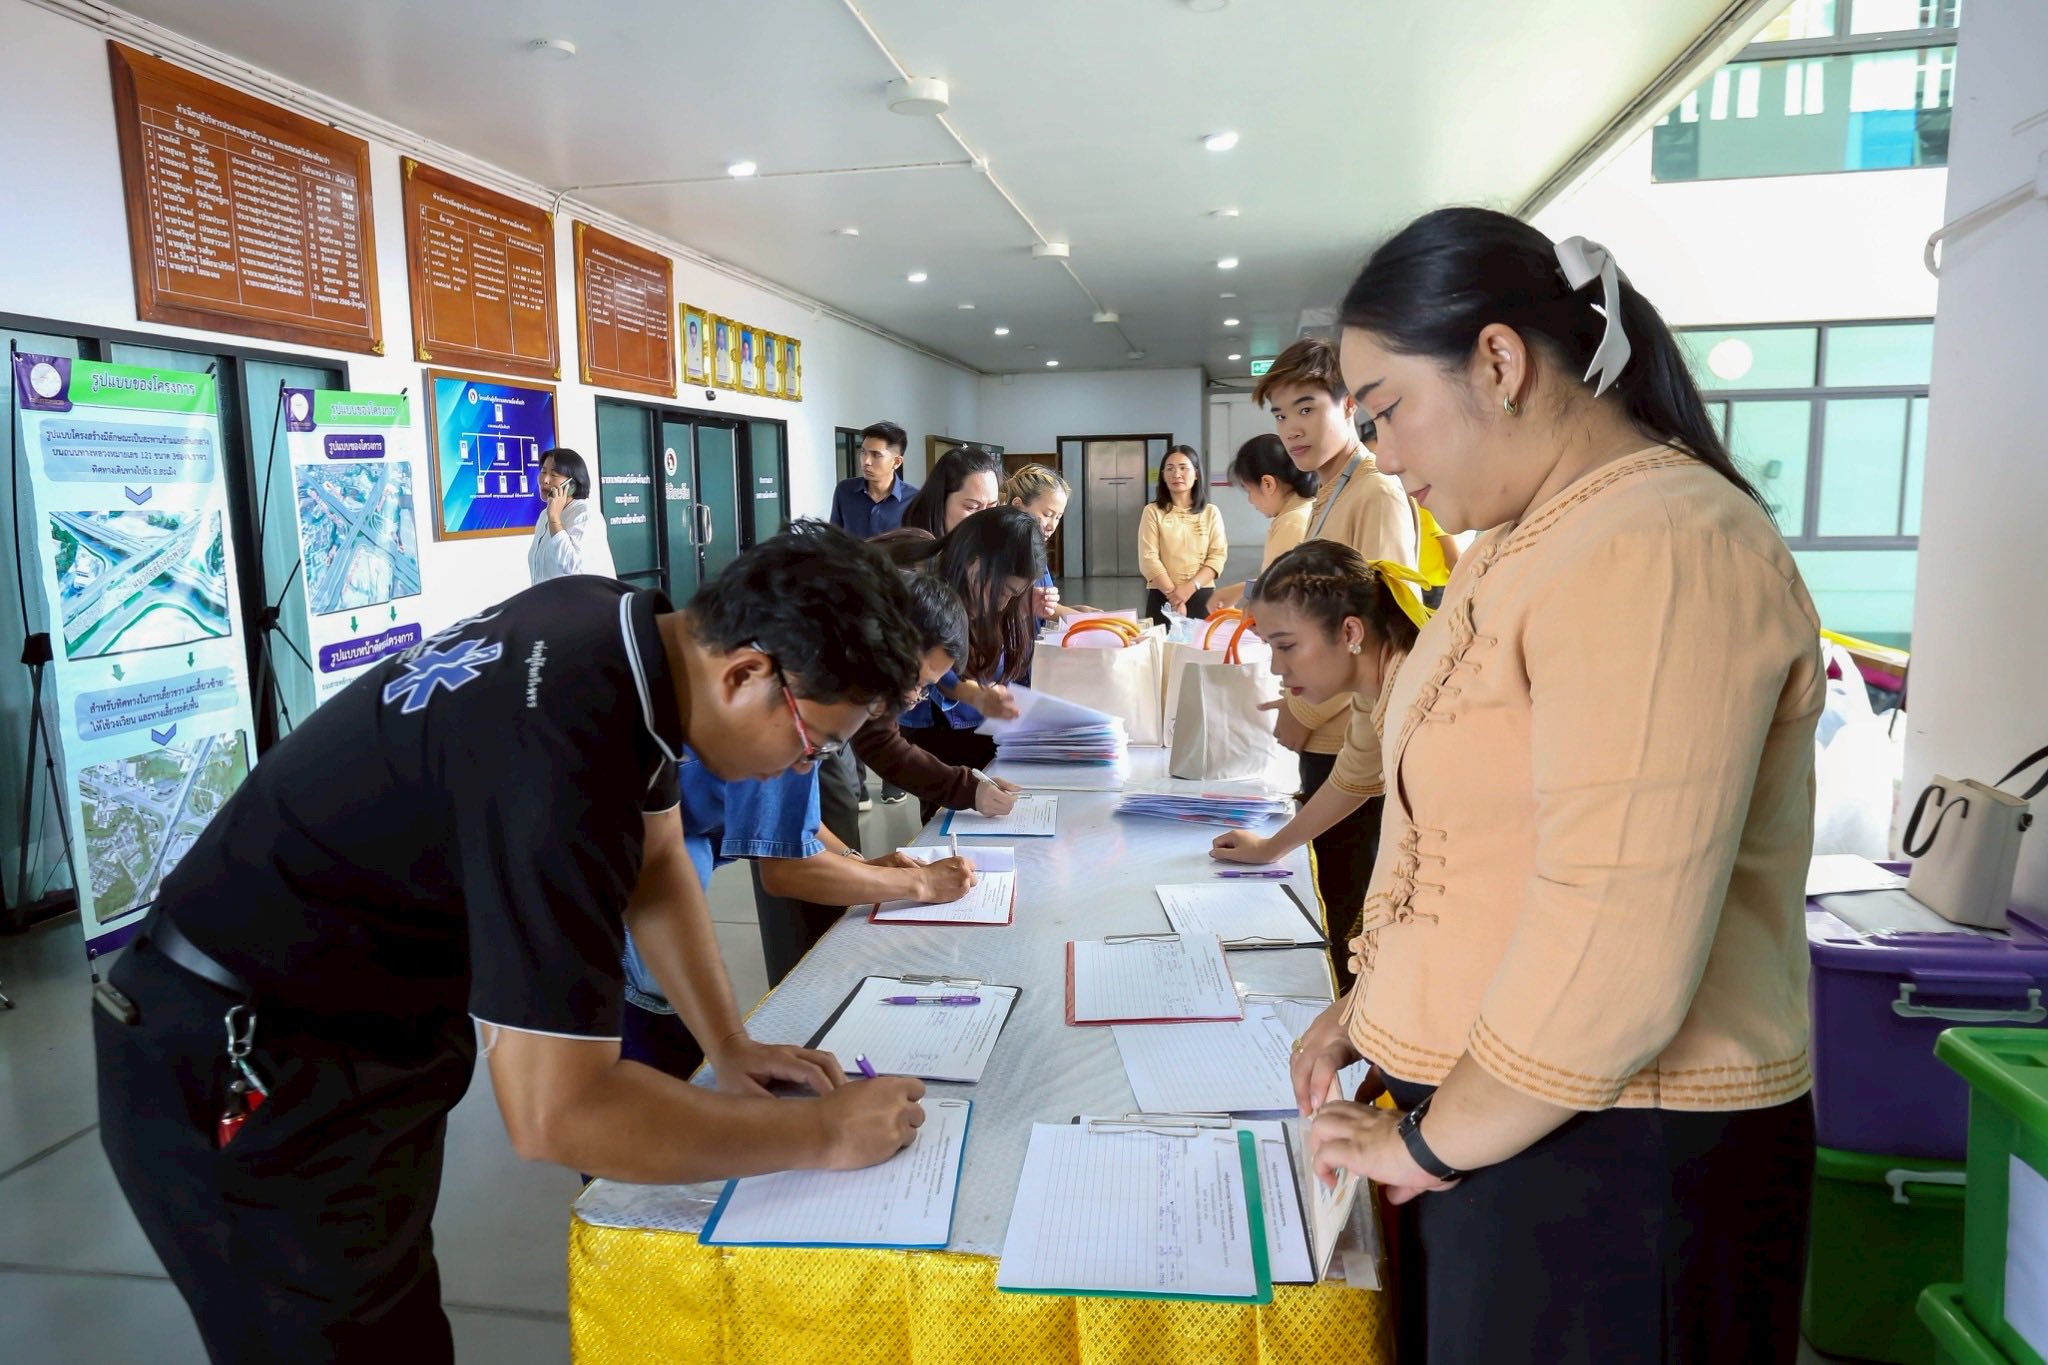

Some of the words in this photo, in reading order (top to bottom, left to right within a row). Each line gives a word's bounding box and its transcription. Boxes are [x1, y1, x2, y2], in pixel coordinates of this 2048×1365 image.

[92, 373, 196, 395] รูปแบบของโครงการ
[331, 401, 396, 420] รูปแบบของโครงการ
[52, 448, 138, 459] บนถนนทางหลวงหมายเลข
[141, 451, 152, 459] 121
[154, 452, 170, 460] ขนาด
[329, 439, 382, 455] รูปแบบของโครงการ
[92, 464, 150, 475] ทิศทางเดินทางไปยัง
[90, 687, 184, 714] สำหรับทิศทางในการเลี้ยวขวา
[186, 678, 224, 694] และเลี้ยวซ้าย
[90, 715, 136, 733] ให้ใช้วงเวียน
[138, 697, 199, 722] และทางเลี้ยวระดับพื้น
